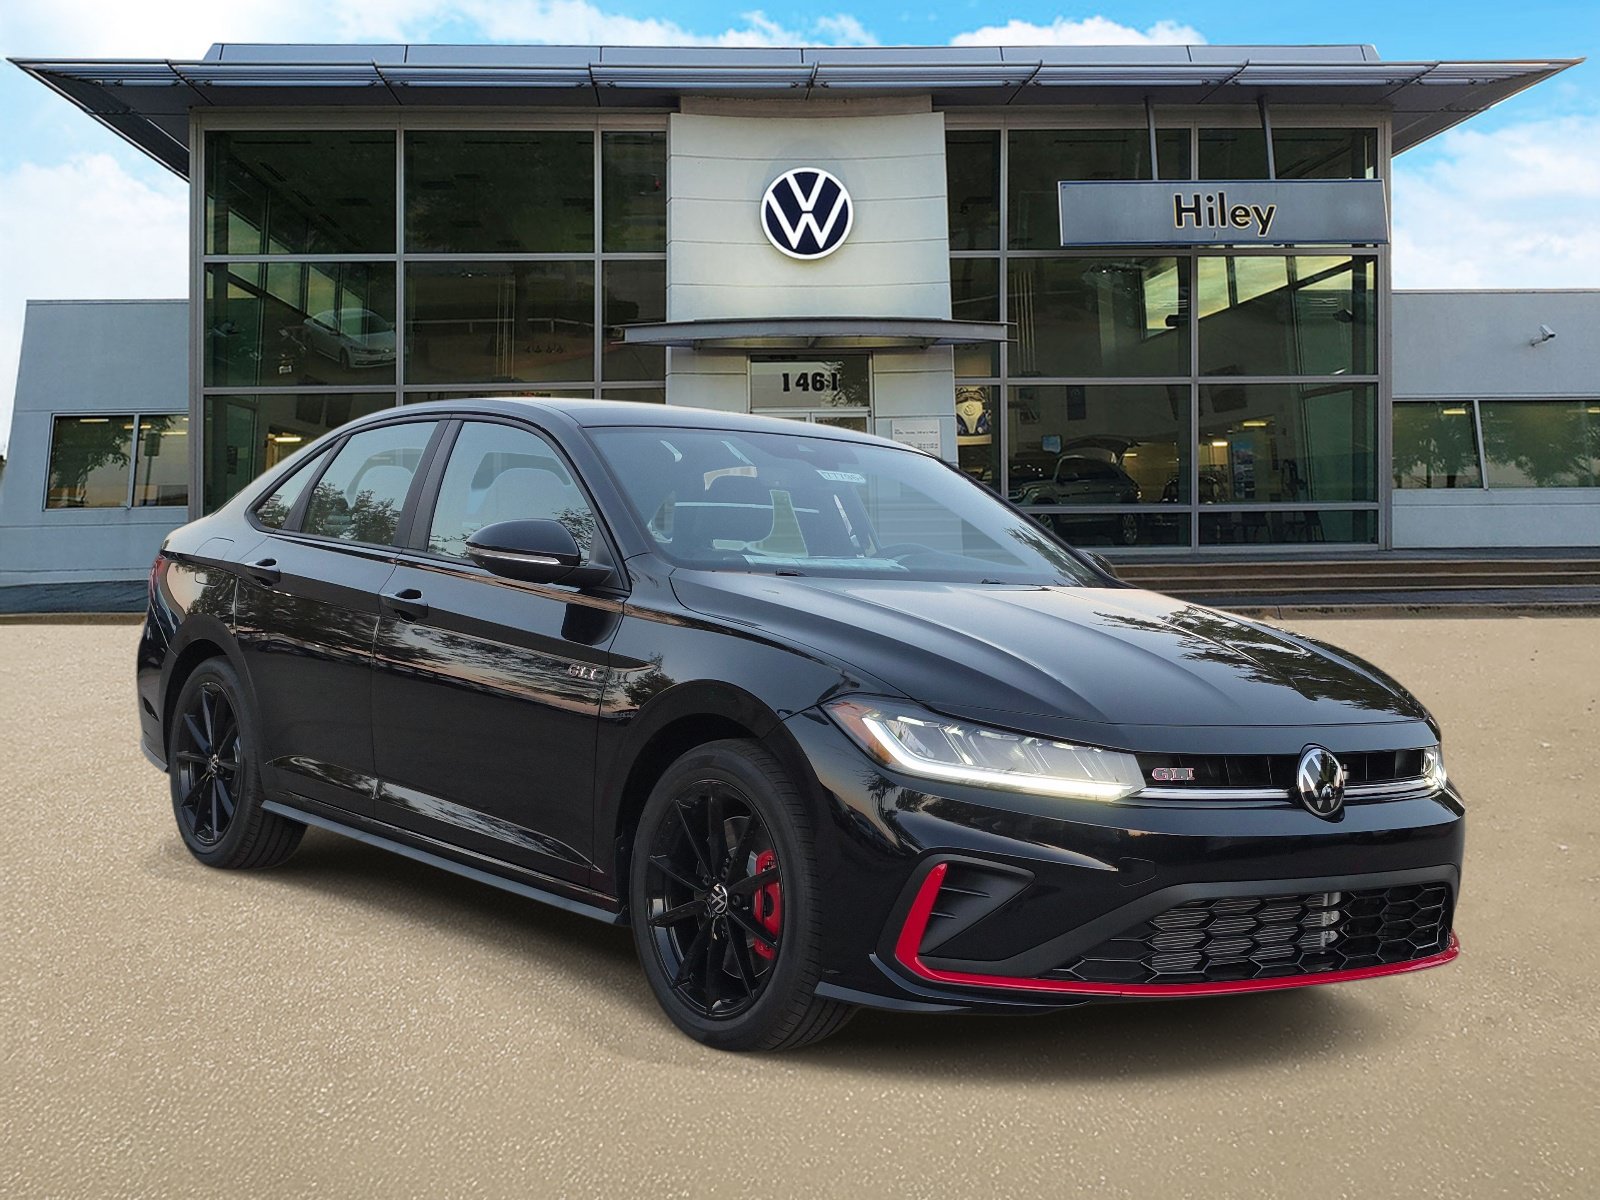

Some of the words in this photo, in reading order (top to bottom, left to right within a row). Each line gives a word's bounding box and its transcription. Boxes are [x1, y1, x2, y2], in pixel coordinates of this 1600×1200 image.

[763, 169, 851, 256] VW
[1174, 191, 1276, 237] Hiley
[782, 372, 838, 392] 1461
[1152, 767, 1195, 780] GLI
